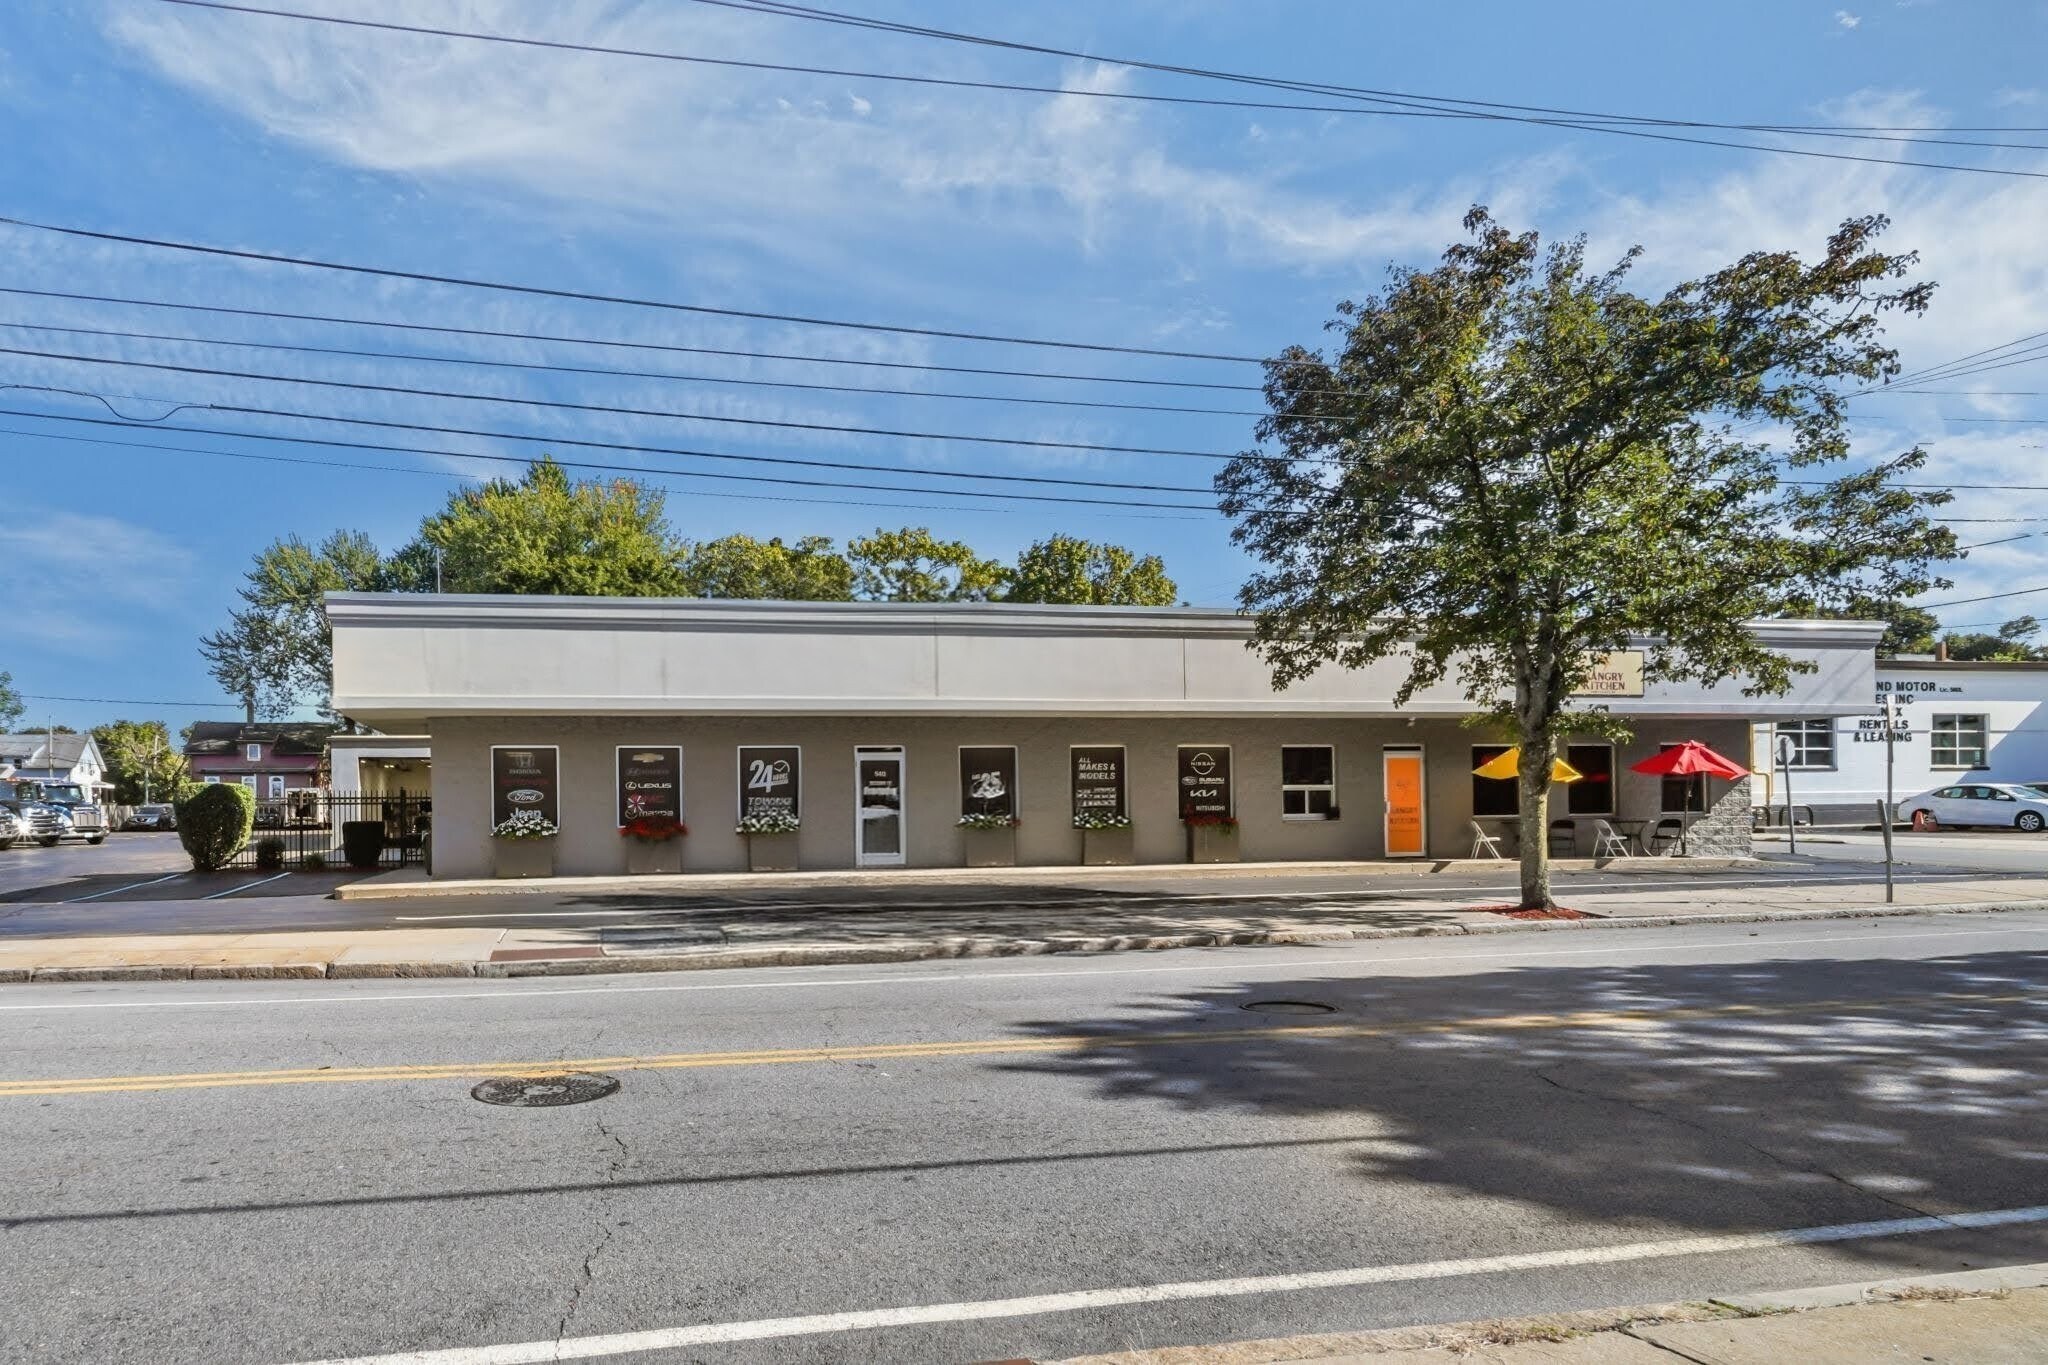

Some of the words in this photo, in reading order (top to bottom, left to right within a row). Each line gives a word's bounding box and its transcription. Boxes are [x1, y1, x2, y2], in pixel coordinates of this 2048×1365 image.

[1587, 671, 1625, 681] ANGRY
[1582, 681, 1626, 690] KITCHEN
[1896, 681, 1936, 692] MOTOR
[1895, 694, 1914, 704] INC
[1859, 719, 1909, 730] RENTLS
[1854, 732, 1861, 742] &
[1079, 763, 1109, 771] MAKES
[1110, 763, 1116, 771] &
[749, 760, 775, 793] 24
[1079, 772, 1116, 780] MODELS
[514, 792, 537, 801] Ford
